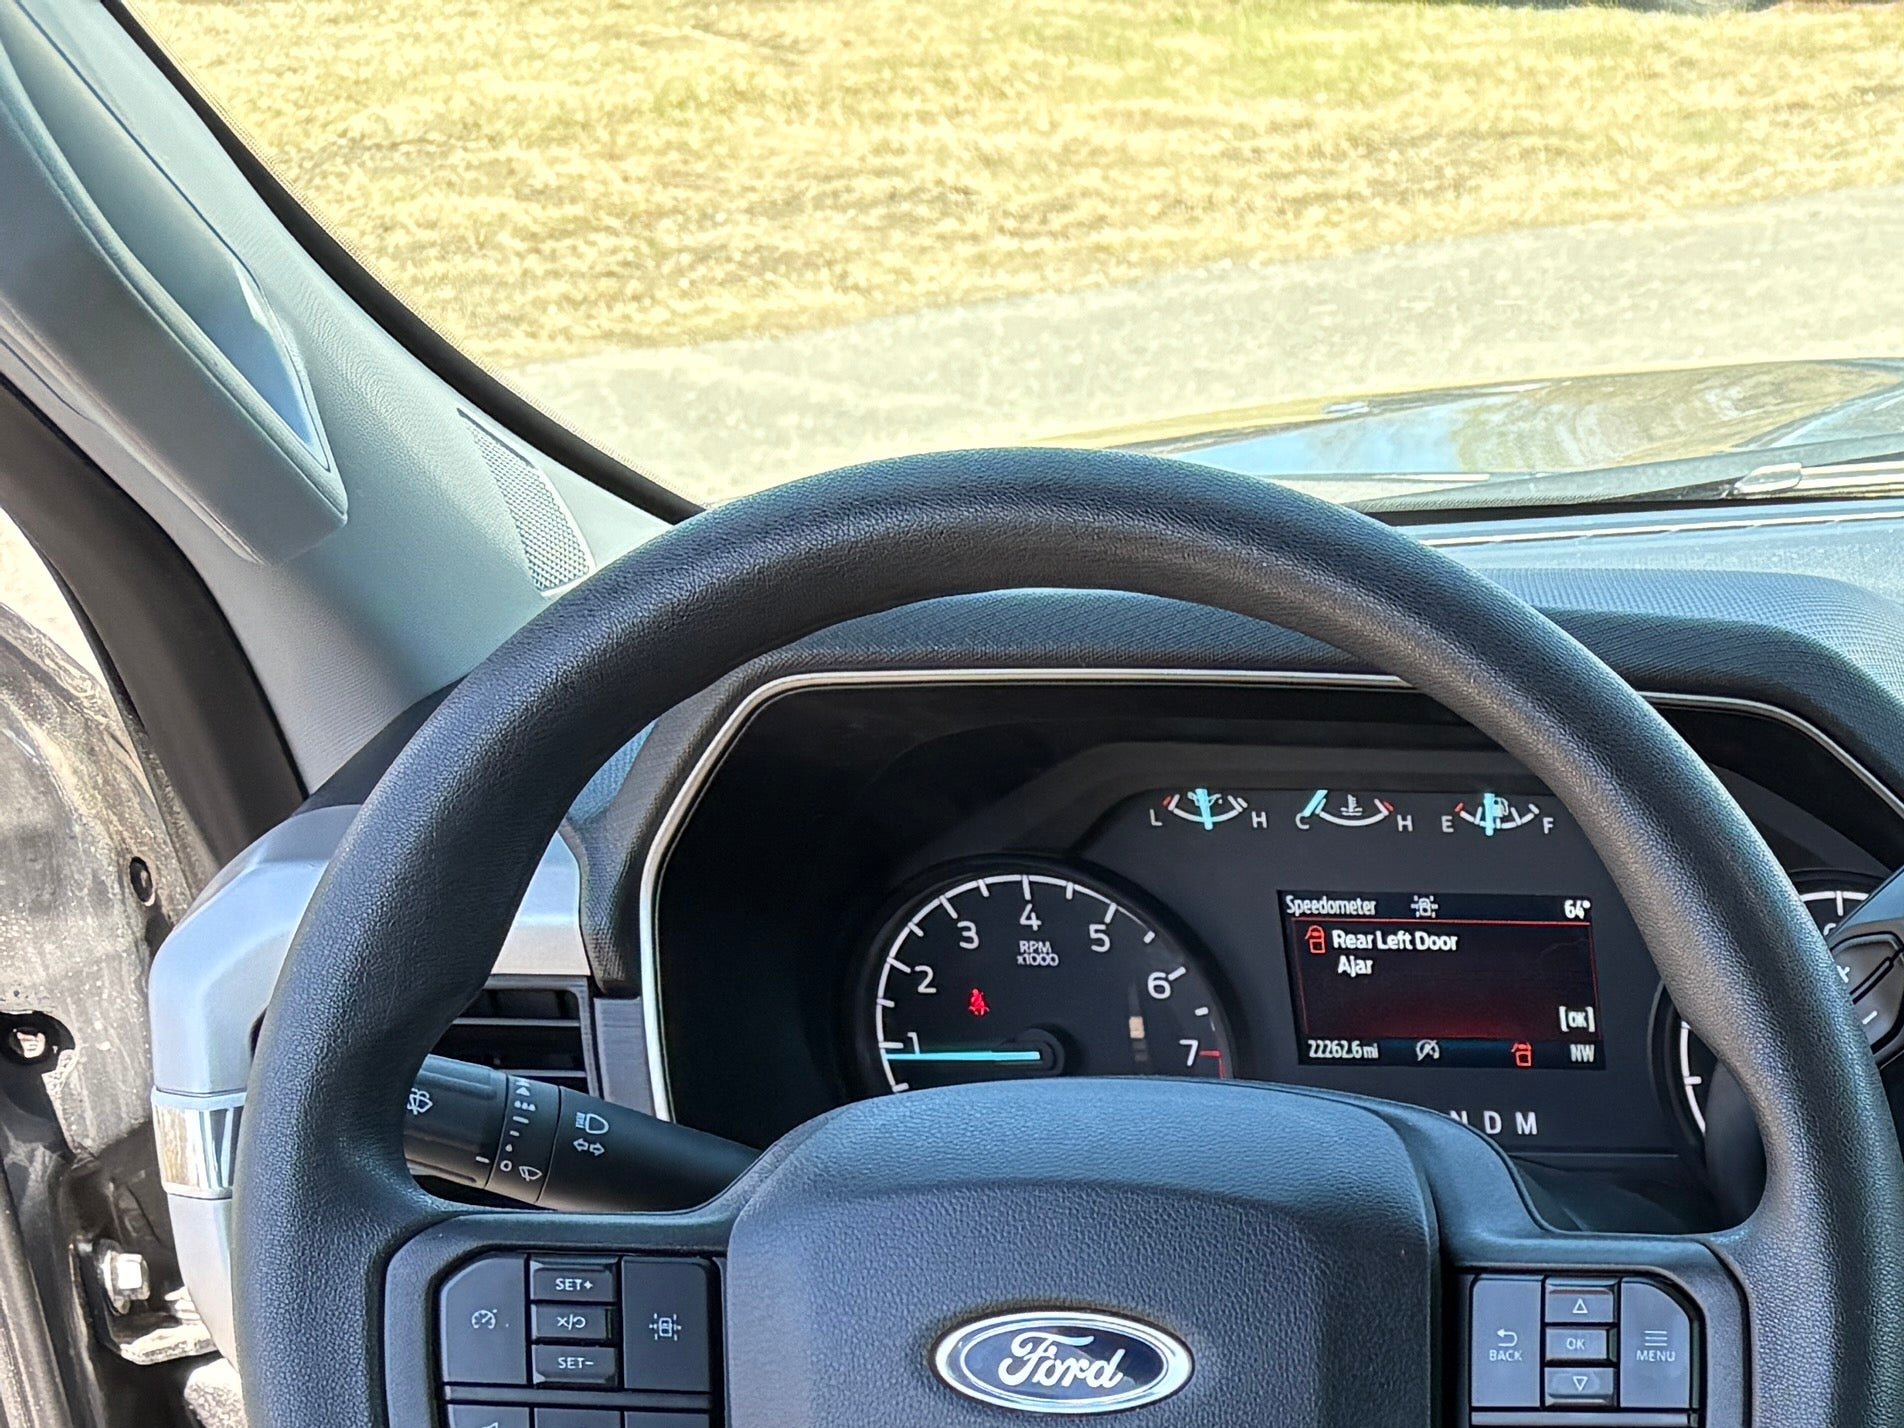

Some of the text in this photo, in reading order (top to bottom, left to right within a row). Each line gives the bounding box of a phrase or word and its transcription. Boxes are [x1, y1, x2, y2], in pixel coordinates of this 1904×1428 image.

[1150, 808, 1162, 827] L
[1253, 811, 1268, 828] H
[1295, 815, 1310, 831] C
[1398, 815, 1413, 832] H
[1442, 816, 1455, 833] E
[1543, 817, 1554, 834] F
[1286, 895, 1377, 916] Speedometer
[1563, 899, 1592, 920] 64°
[1019, 903, 1042, 931] 4
[957, 920, 980, 950] 3
[1088, 923, 1111, 953] 5
[1332, 929, 1459, 951] Rear Left Door
[1018, 939, 1053, 955] RPM
[1016, 952, 1060, 967] x1000
[1337, 955, 1374, 978] Ajar
[914, 965, 938, 993] 2
[1147, 971, 1172, 1000] 6
[1178, 1039, 1200, 1067] 7
[1569, 1044, 1596, 1063] NW
[1483, 1110, 1502, 1134] D
[1515, 1111, 1538, 1135] M
[1566, 1337, 1586, 1351] OK
[997, 1330, 1126, 1390] Ford
[1489, 1349, 1523, 1363] BACK
[1636, 1349, 1677, 1363] MENU
